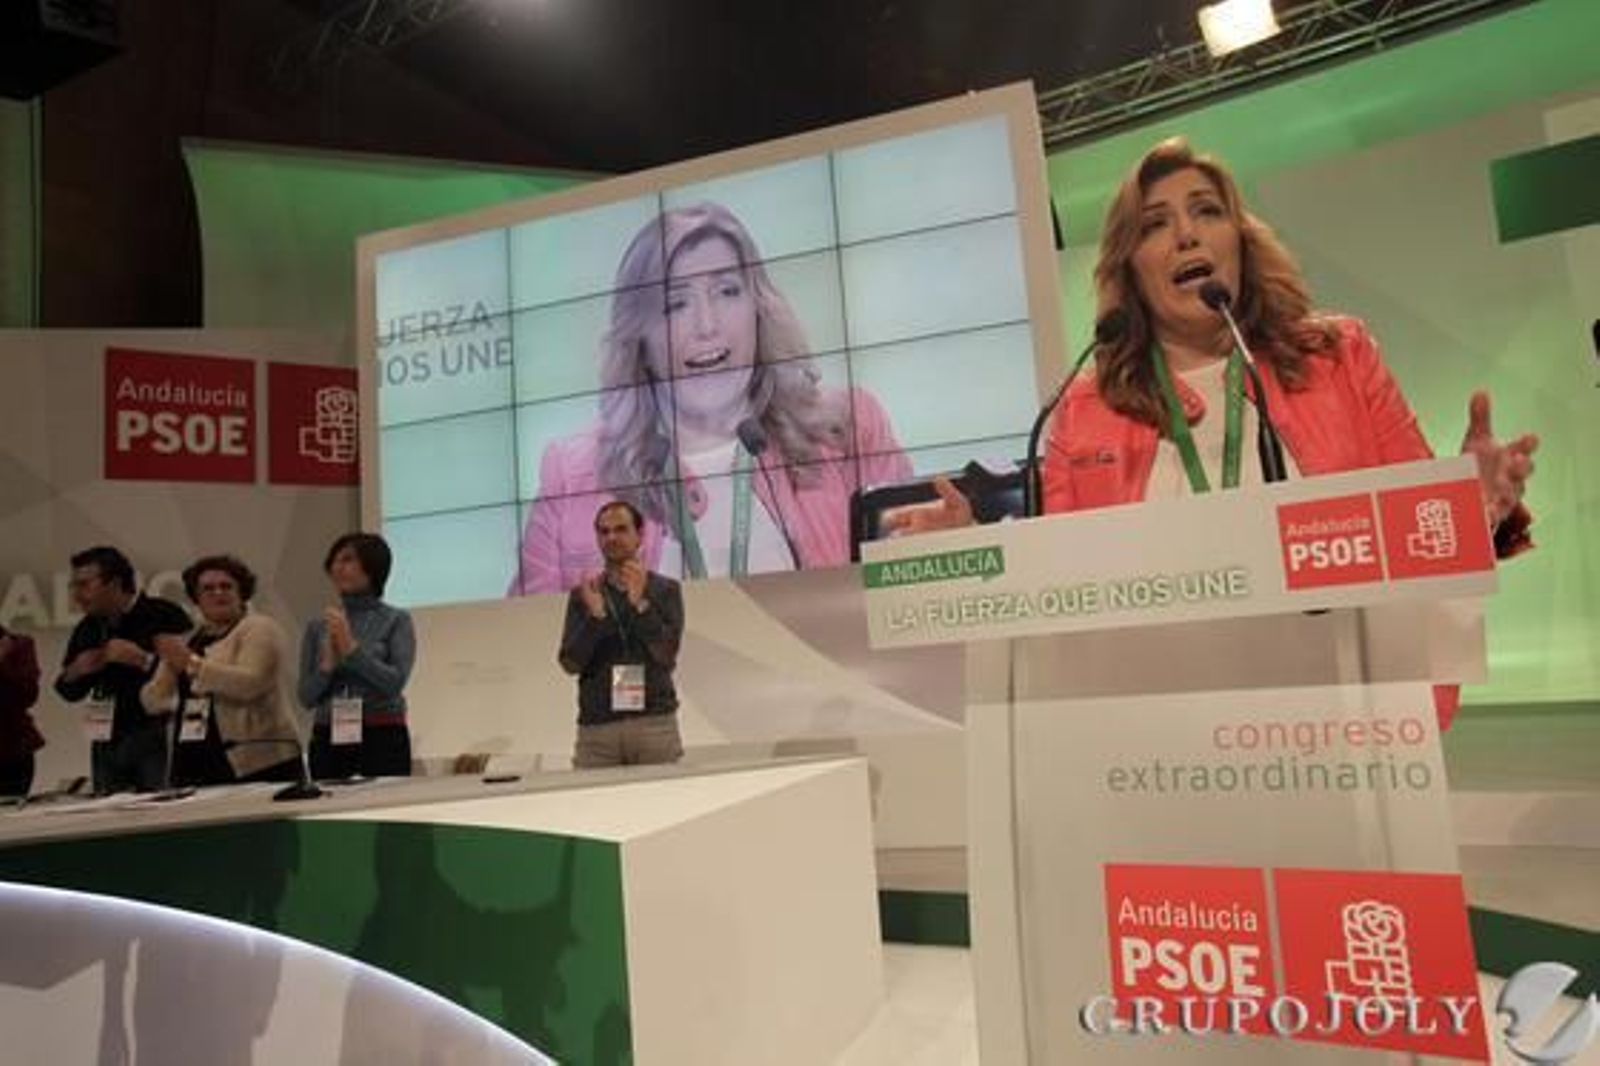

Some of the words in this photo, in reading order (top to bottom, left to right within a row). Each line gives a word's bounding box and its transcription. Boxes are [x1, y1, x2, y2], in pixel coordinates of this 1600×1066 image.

[441, 338, 513, 376] UNE
[116, 409, 247, 455] PSOE
[1288, 535, 1375, 571] PSOE
[889, 608, 918, 630] LA
[926, 593, 1034, 626] FUERZA
[1041, 586, 1098, 616] QUE
[1109, 577, 1172, 608] NOS
[1180, 568, 1249, 600] UNE
[1212, 716, 1426, 755] congreso
[1106, 757, 1432, 793] extraordinario
[1120, 935, 1266, 999] PSOE
